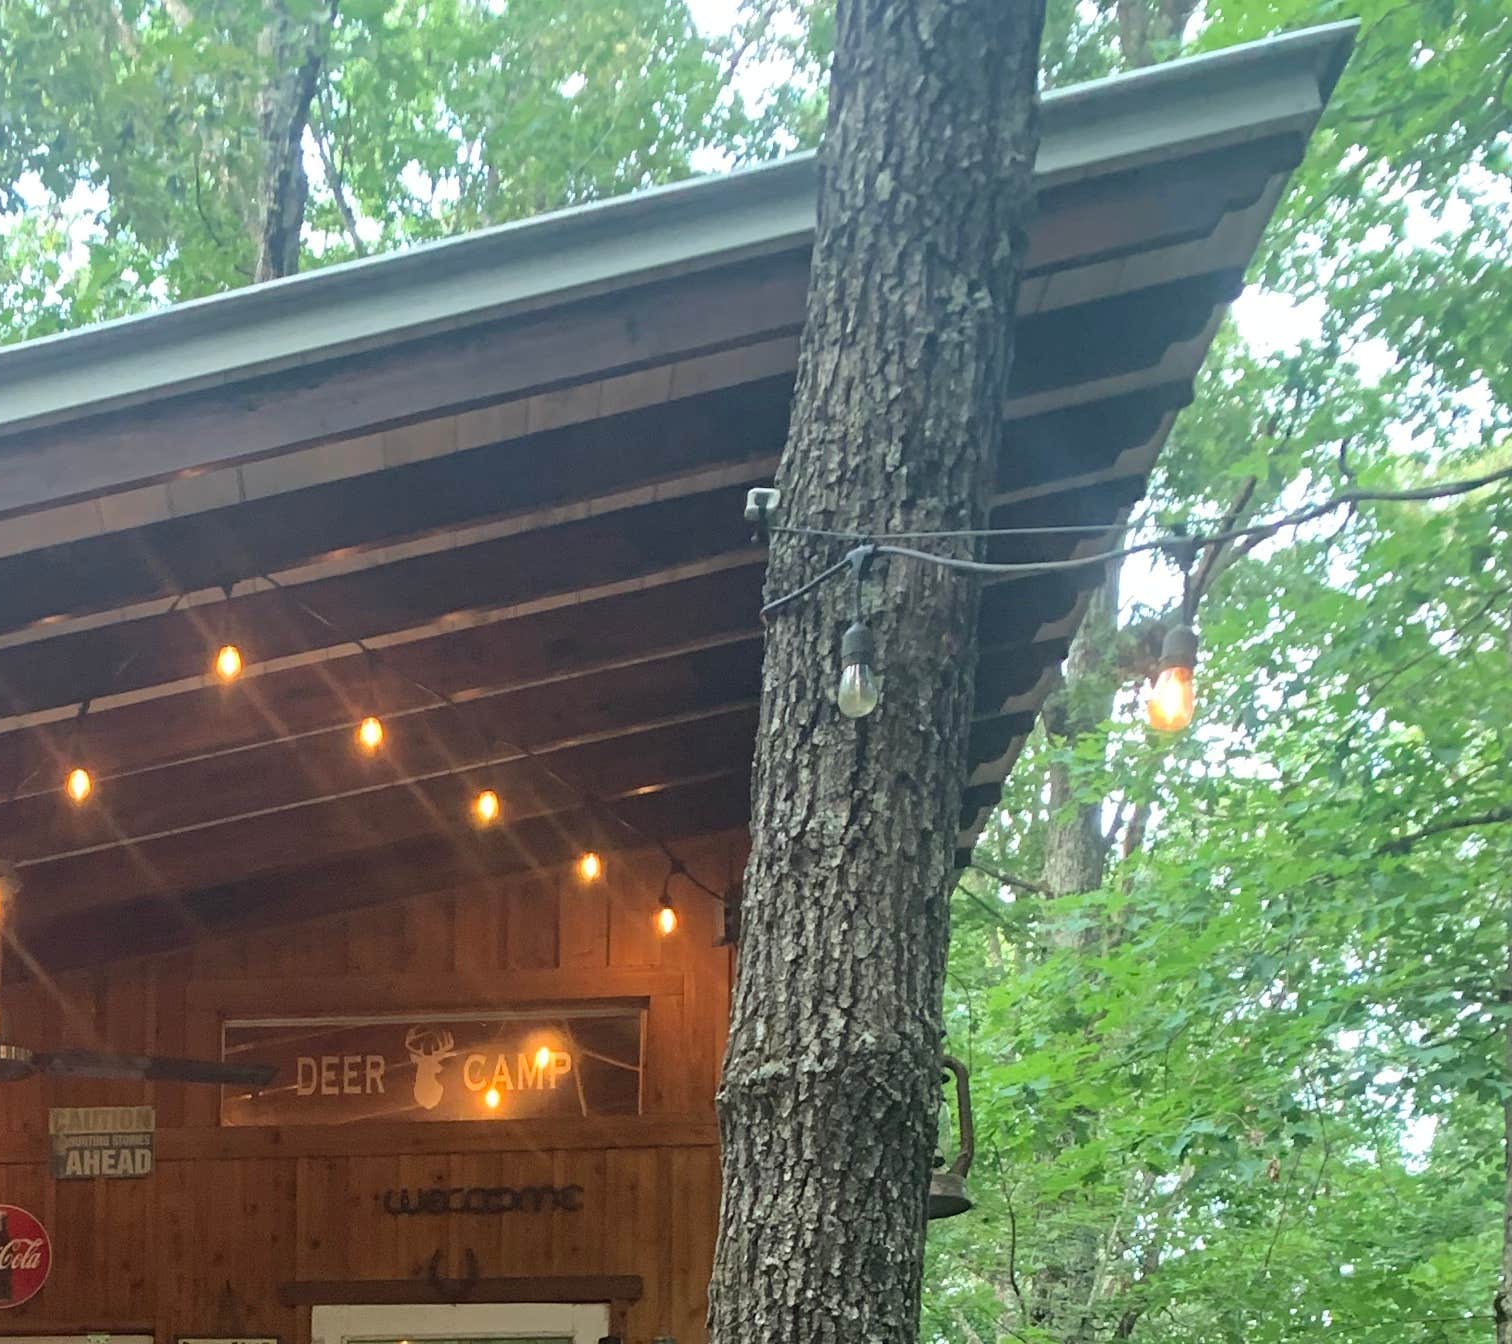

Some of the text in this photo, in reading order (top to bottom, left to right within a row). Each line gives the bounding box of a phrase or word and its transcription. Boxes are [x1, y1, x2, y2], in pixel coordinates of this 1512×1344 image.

[295, 1050, 572, 1097] DEER CAMP
[54, 1108, 152, 1132] CAUTION
[65, 1148, 152, 1175] AHEAD
